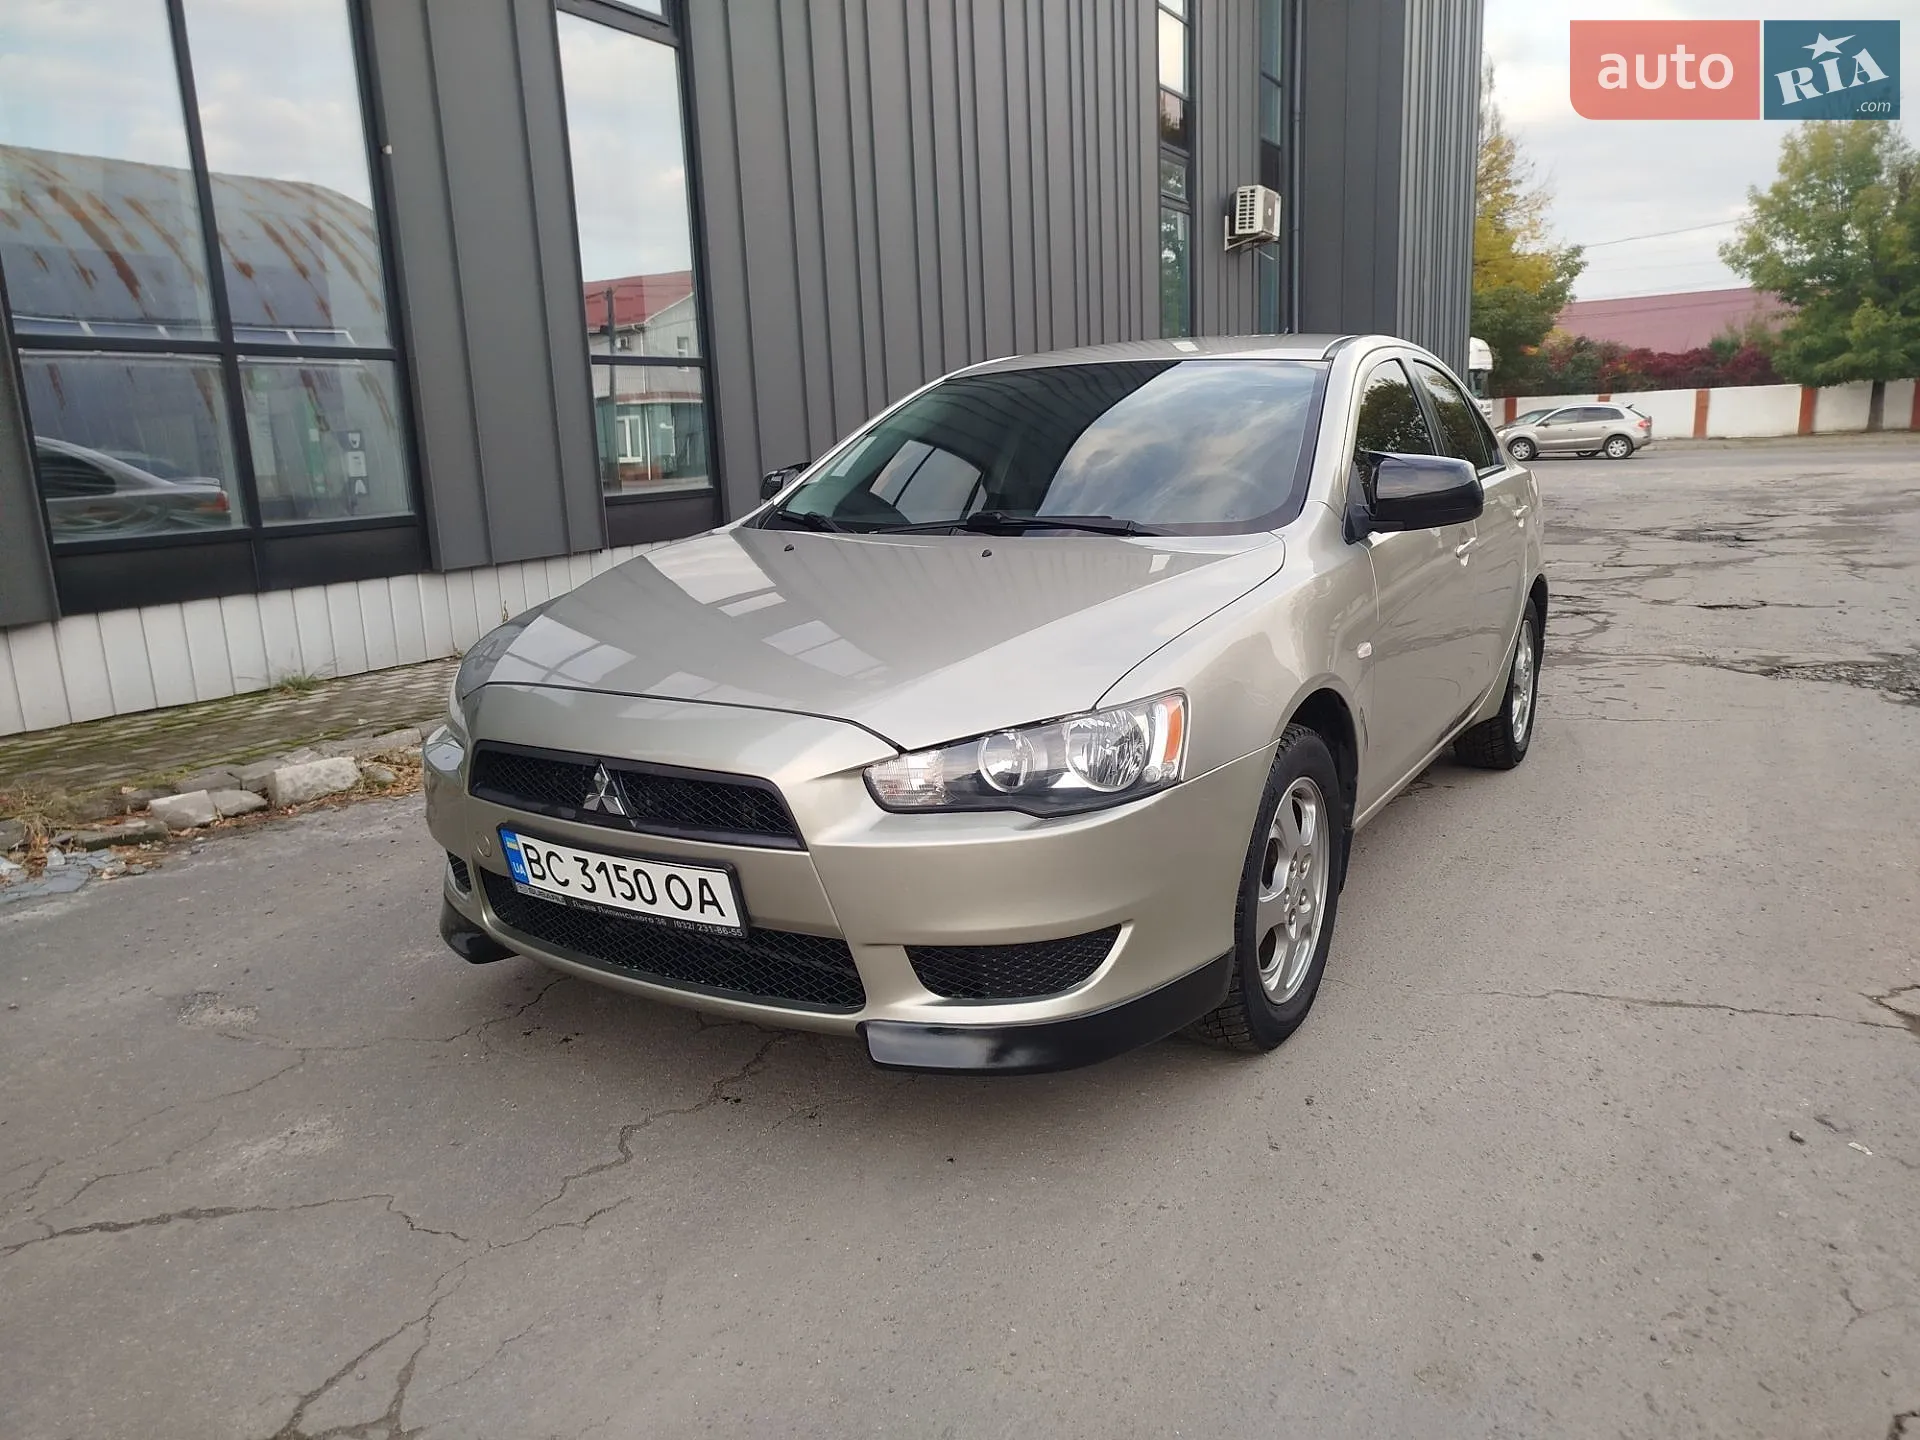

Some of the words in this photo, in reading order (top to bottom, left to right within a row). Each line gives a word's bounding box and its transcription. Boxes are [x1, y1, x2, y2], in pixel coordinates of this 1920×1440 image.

[512, 861, 526, 876] UA
[522, 842, 570, 887] BC
[573, 856, 658, 905] 3150
[665, 873, 726, 918] OA
